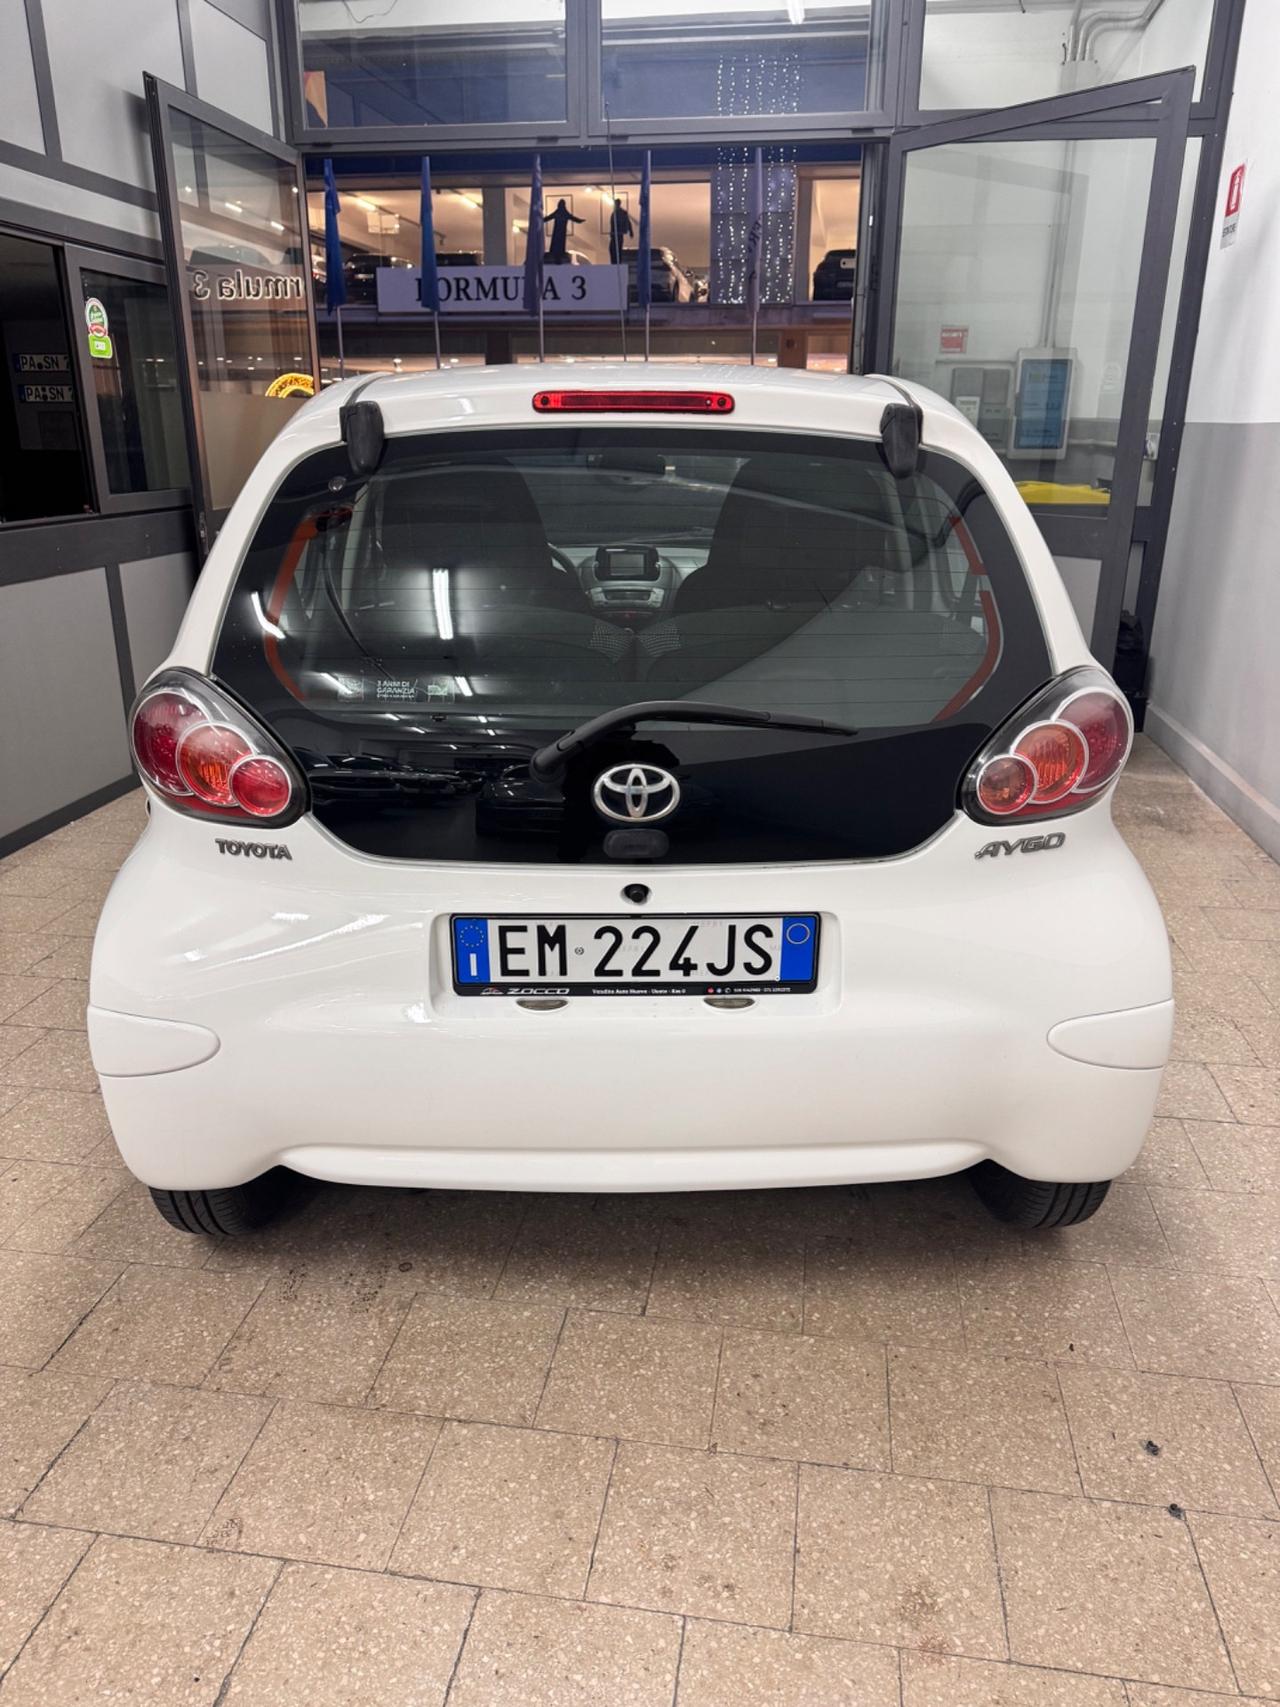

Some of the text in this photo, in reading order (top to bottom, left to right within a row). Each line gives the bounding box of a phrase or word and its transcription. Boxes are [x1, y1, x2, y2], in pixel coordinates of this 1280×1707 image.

[571, 276, 587, 300] 3
[215, 838, 293, 860] TOYOTA
[974, 831, 1066, 860] AYGO
[498, 924, 568, 977] EM
[594, 924, 774, 977] 224JS
